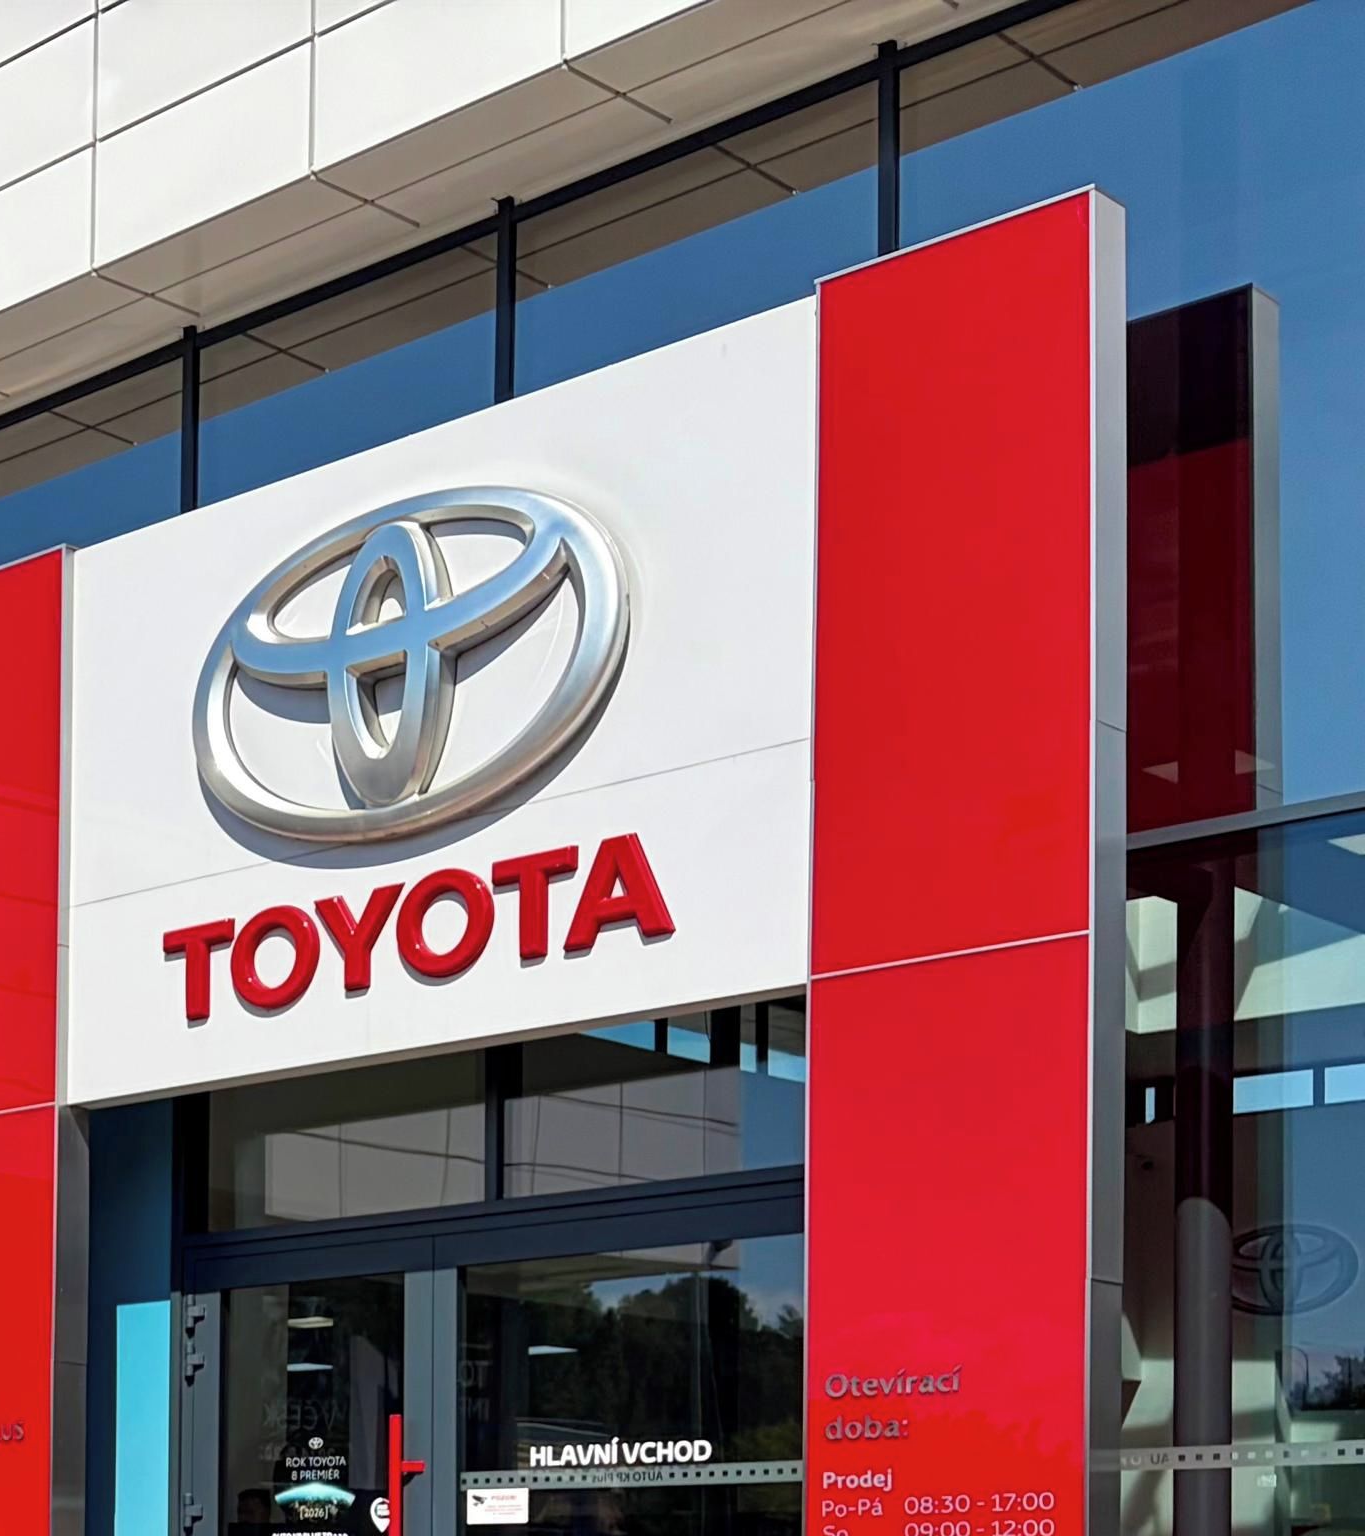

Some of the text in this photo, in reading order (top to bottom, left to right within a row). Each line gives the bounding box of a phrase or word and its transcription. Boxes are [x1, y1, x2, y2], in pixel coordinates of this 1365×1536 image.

[163, 832, 675, 1021] TOYOTA
[825, 1365, 962, 1398] Otevírací
[825, 1416, 909, 1440] doba:
[286, 1456, 346, 1468] ROK TOYOTA
[530, 1437, 712, 1467] HLAVNÍ VCHOD
[299, 1468, 340, 1480] PREMIÉR
[822, 1469, 893, 1492] Prodej
[822, 1498, 883, 1517] Po-Pá
[904, 1495, 971, 1515] 08:30
[991, 1492, 1055, 1512] 17:00
